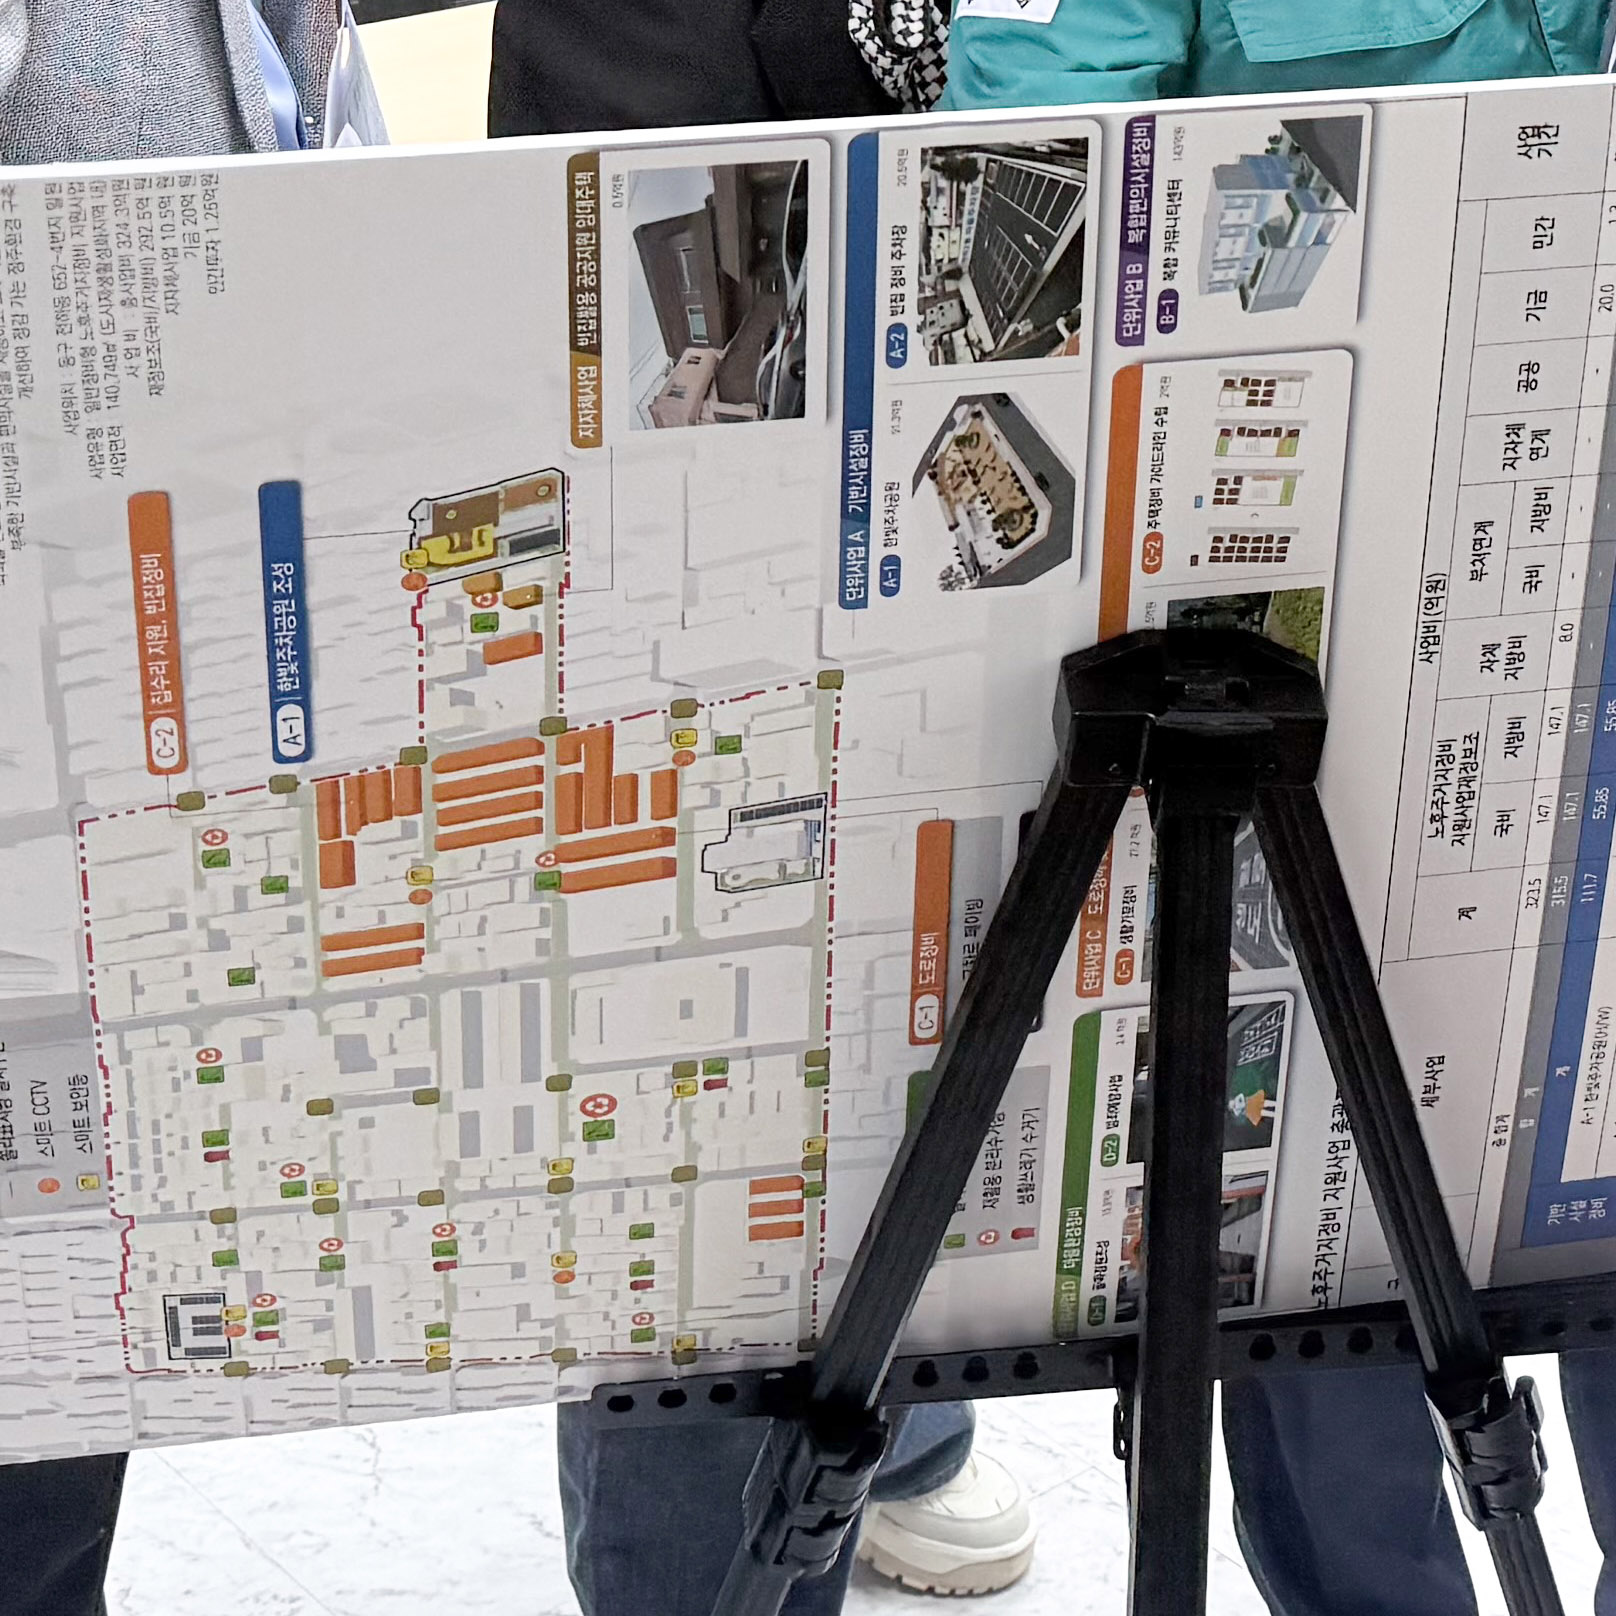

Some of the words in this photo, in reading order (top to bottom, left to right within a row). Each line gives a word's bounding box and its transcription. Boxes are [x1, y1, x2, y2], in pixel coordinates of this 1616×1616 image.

[1516, 125, 1540, 159] 사업
[1535, 123, 1560, 158] 기간
[574, 171, 596, 228] 임대주택
[1128, 121, 1152, 244] 복합편의시설정비
[1163, 178, 1184, 254] 커뮤니티센터
[1531, 215, 1556, 250] 민간
[575, 232, 597, 288] 공공지원
[890, 225, 908, 261] 주차장
[889, 264, 906, 288] 정비
[1126, 262, 1143, 275] B
[1161, 258, 1180, 282] 복합
[888, 293, 905, 317] 빈집
[1121, 279, 1142, 337] 단위사업
[1160, 297, 1176, 326] B-1
[1524, 289, 1549, 322] 기금
[1599, 283, 1615, 313] 20.0
[576, 292, 598, 346] 빈집활용
[888, 332, 904, 360] A-2
[1516, 360, 1541, 393] 공공
[576, 365, 598, 438] 지자체사업
[1152, 405, 1169, 428] 수립
[1149, 431, 1168, 484] 가이드라인
[1502, 422, 1526, 471] 지자체
[1529, 429, 1552, 462] 연계
[847, 429, 870, 513] 기반시설정비
[883, 481, 900, 548] 한빛주차공원
[1147, 488, 1165, 530] 주택정비
[1529, 486, 1554, 533] 지방비
[847, 529, 865, 543] A
[1144, 540, 1161, 566] C-2
[1468, 519, 1495, 585] 부처연계
[140, 553, 166, 614] 빈집정비
[271, 562, 296, 594] 조성
[845, 545, 867, 601] 단위사업
[883, 562, 898, 588] A-1
[1523, 564, 1545, 594] 국비
[1418, 572, 1447, 664] 사업비(억원)
[1559, 623, 1574, 643] 8.0
[145, 619, 169, 655] 지원,
[273, 599, 300, 692] 한빛주차공원
[1479, 643, 1501, 674] 자체
[1504, 635, 1528, 681] 지방비
[148, 660, 173, 705] 집수리
[155, 727, 175, 759] C-2
[281, 716, 301, 747] A-1
[1503, 715, 1526, 759] 지방비
[1427, 738, 1458, 839] 노후주거지정비
[1451, 730, 1480, 846] 지원사업재정보조
[1592, 786, 1610, 819] 55.85
[1494, 808, 1516, 838] 국비
[1525, 878, 1542, 910] 323.5
[1552, 875, 1569, 907] 315.5
[1581, 873, 1597, 903] 111.7
[1458, 906, 1477, 921] 계
[1088, 930, 1102, 940] C
[919, 932, 939, 985] 도로정비
[1081, 944, 1103, 991] 단위사업
[1119, 956, 1132, 978] C-1
[917, 1005, 935, 1030] C-1
[30, 1079, 51, 1116] CCTV
[68, 1074, 90, 1112] 보안등
[1421, 1054, 1445, 1109] 세부사업
[1580, 1106, 1594, 1125] A-1
[33, 1121, 54, 1158] 스마트
[72, 1116, 93, 1154] 스마트
[1322, 1140, 1350, 1202] 지원사업
[1311, 1206, 1343, 1309] 노후주거지정비
